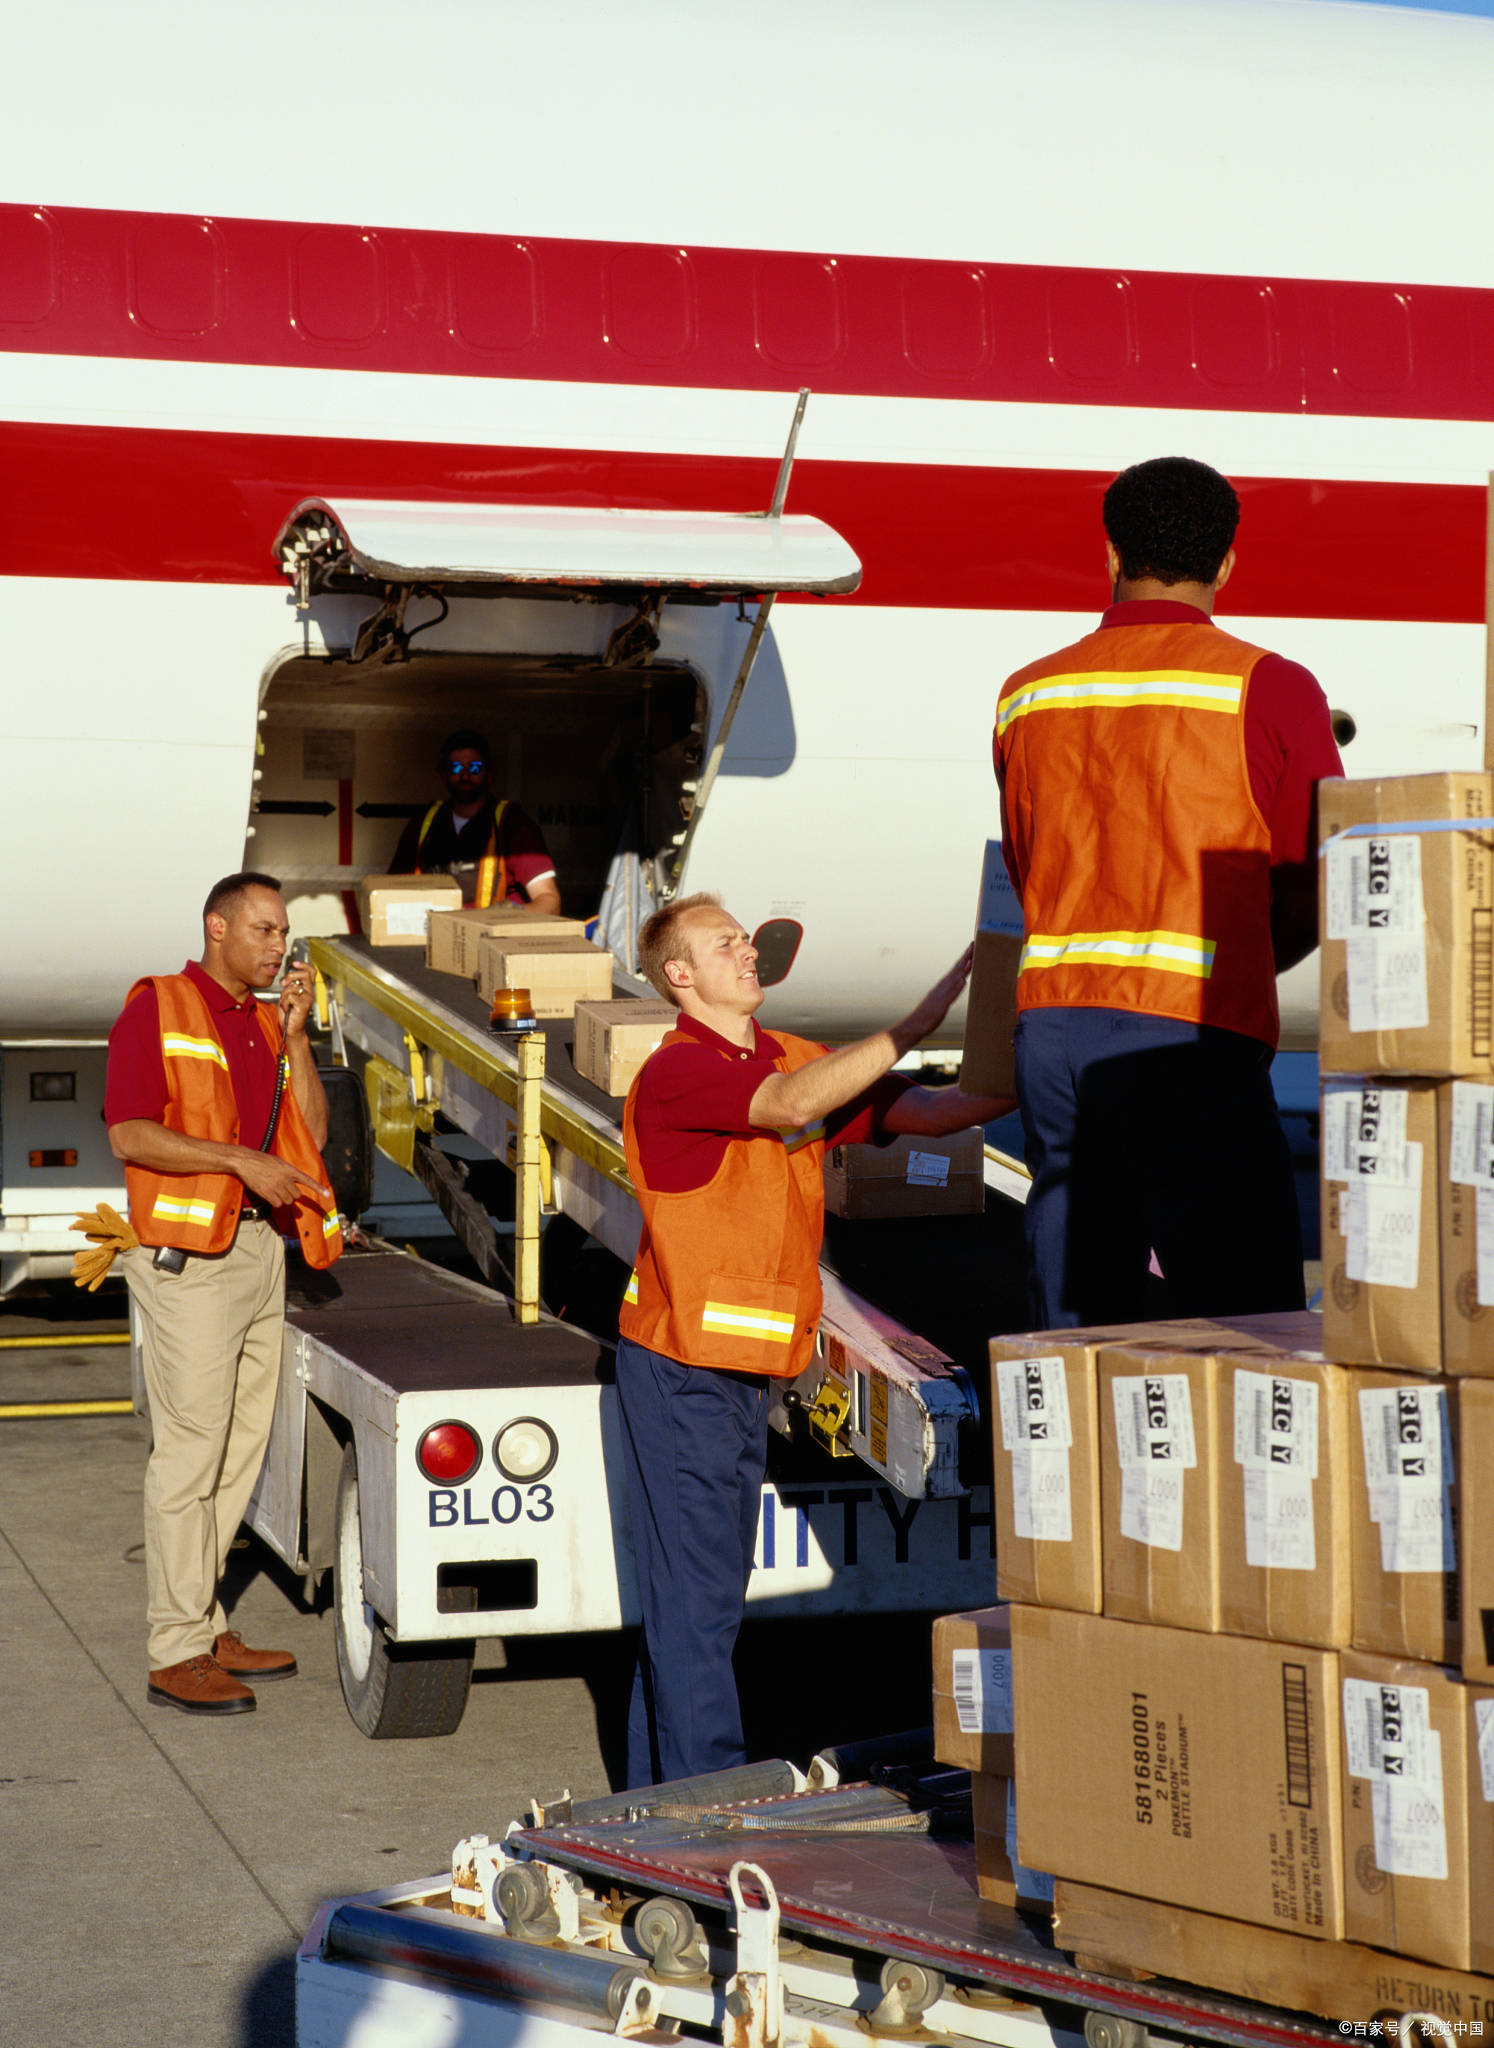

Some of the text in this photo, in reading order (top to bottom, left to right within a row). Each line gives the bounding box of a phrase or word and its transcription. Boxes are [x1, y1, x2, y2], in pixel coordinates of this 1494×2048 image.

[1369, 841, 1389, 927] RIC Y
[1359, 1089, 1381, 1174] RIC Y
[1024, 1361, 1047, 1440] RIC Y
[1145, 1378, 1171, 1459] RIC Y
[1271, 1379, 1292, 1464] RIC Y
[1397, 1389, 1425, 1476] RIC Y
[752, 1487, 922, 1569] ITTY
[992, 1655, 1005, 1689] 0007
[1131, 1691, 1153, 1825] 581680001
[1154, 1720, 1168, 1801] 2 Pieces
[1380, 1686, 1403, 1775] RIC Y
[1181, 1790, 1192, 1839] BATTLE
[1309, 1827, 1320, 1869] CHINA
[1287, 1864, 1297, 1891] CODE
[1288, 1895, 1298, 1921] DATE
[1313, 1890, 1324, 1927] Made
[1376, 1975, 1461, 2017] RETURN
